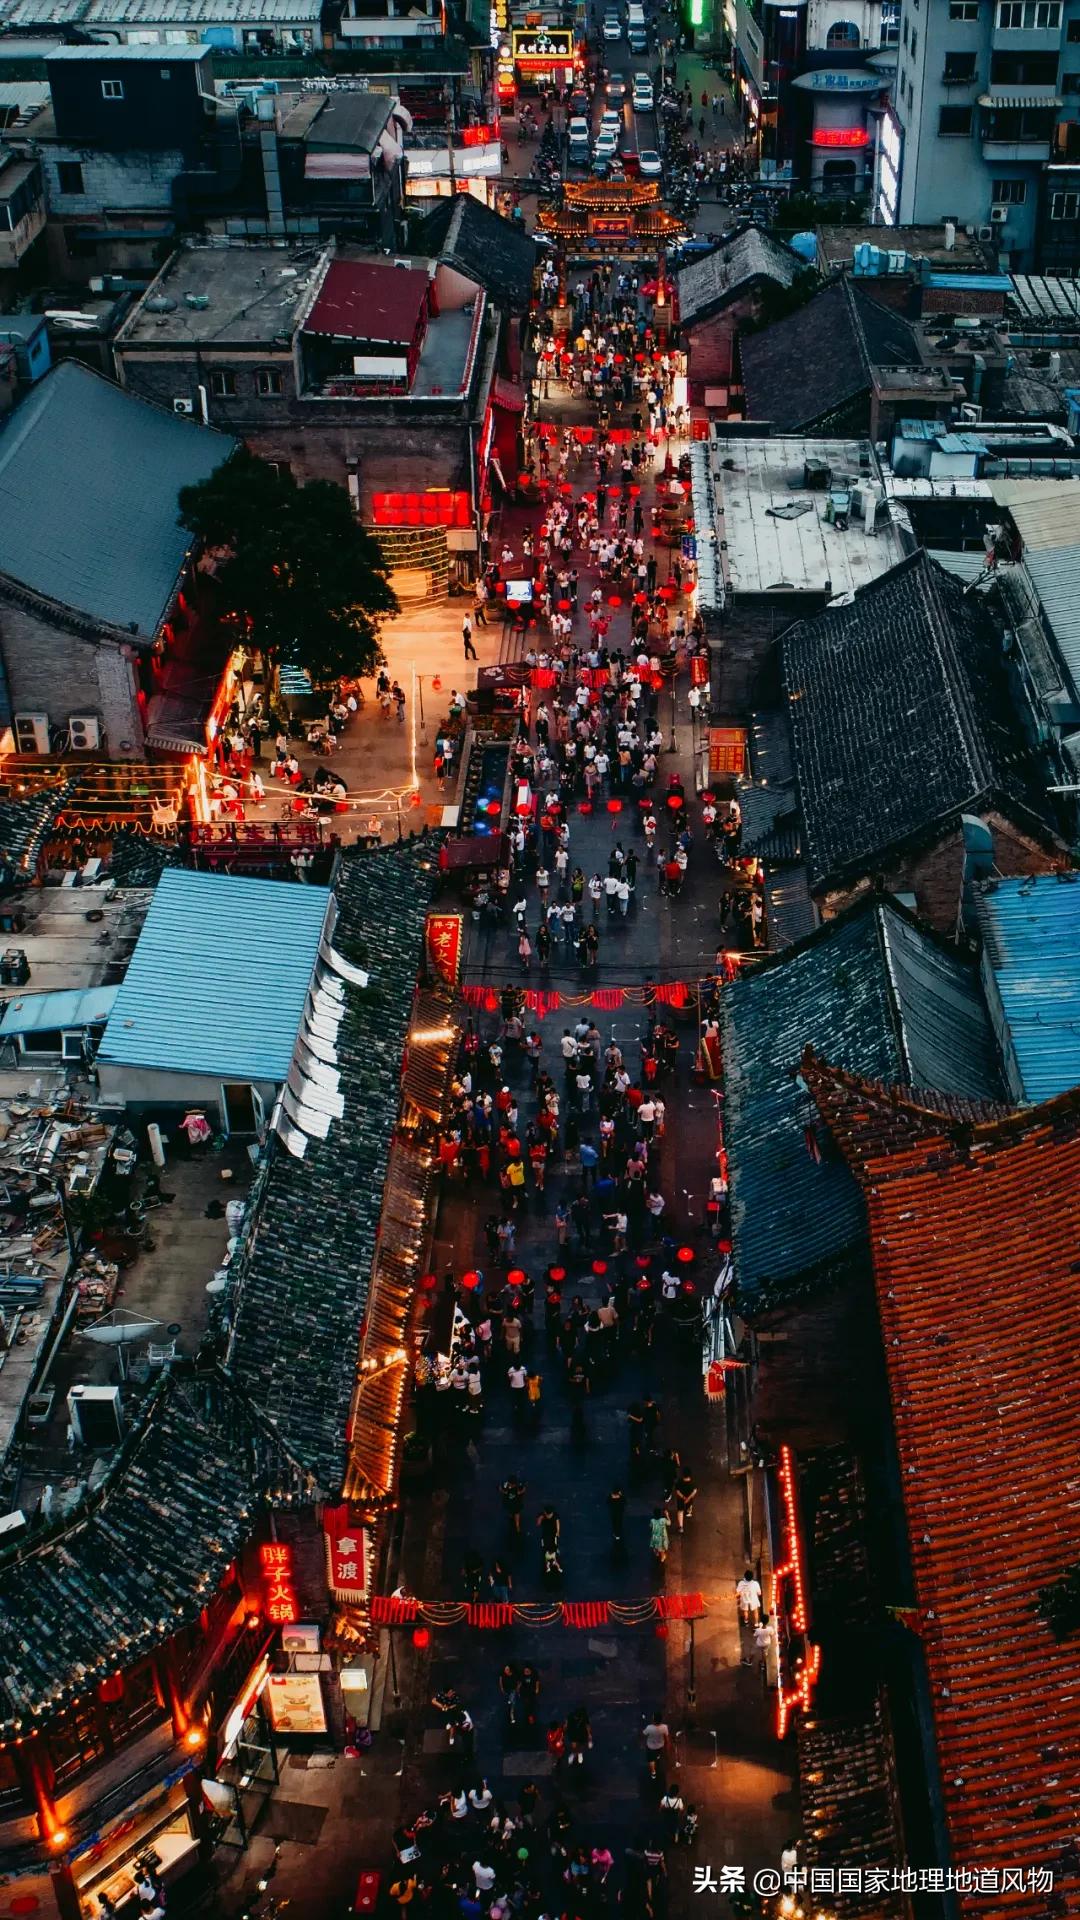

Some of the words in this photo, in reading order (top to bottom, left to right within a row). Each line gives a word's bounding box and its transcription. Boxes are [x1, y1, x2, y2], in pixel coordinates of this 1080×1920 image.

[262, 1546, 295, 1621] 胖子火锅
[336, 1537, 358, 1580] 拿渡
